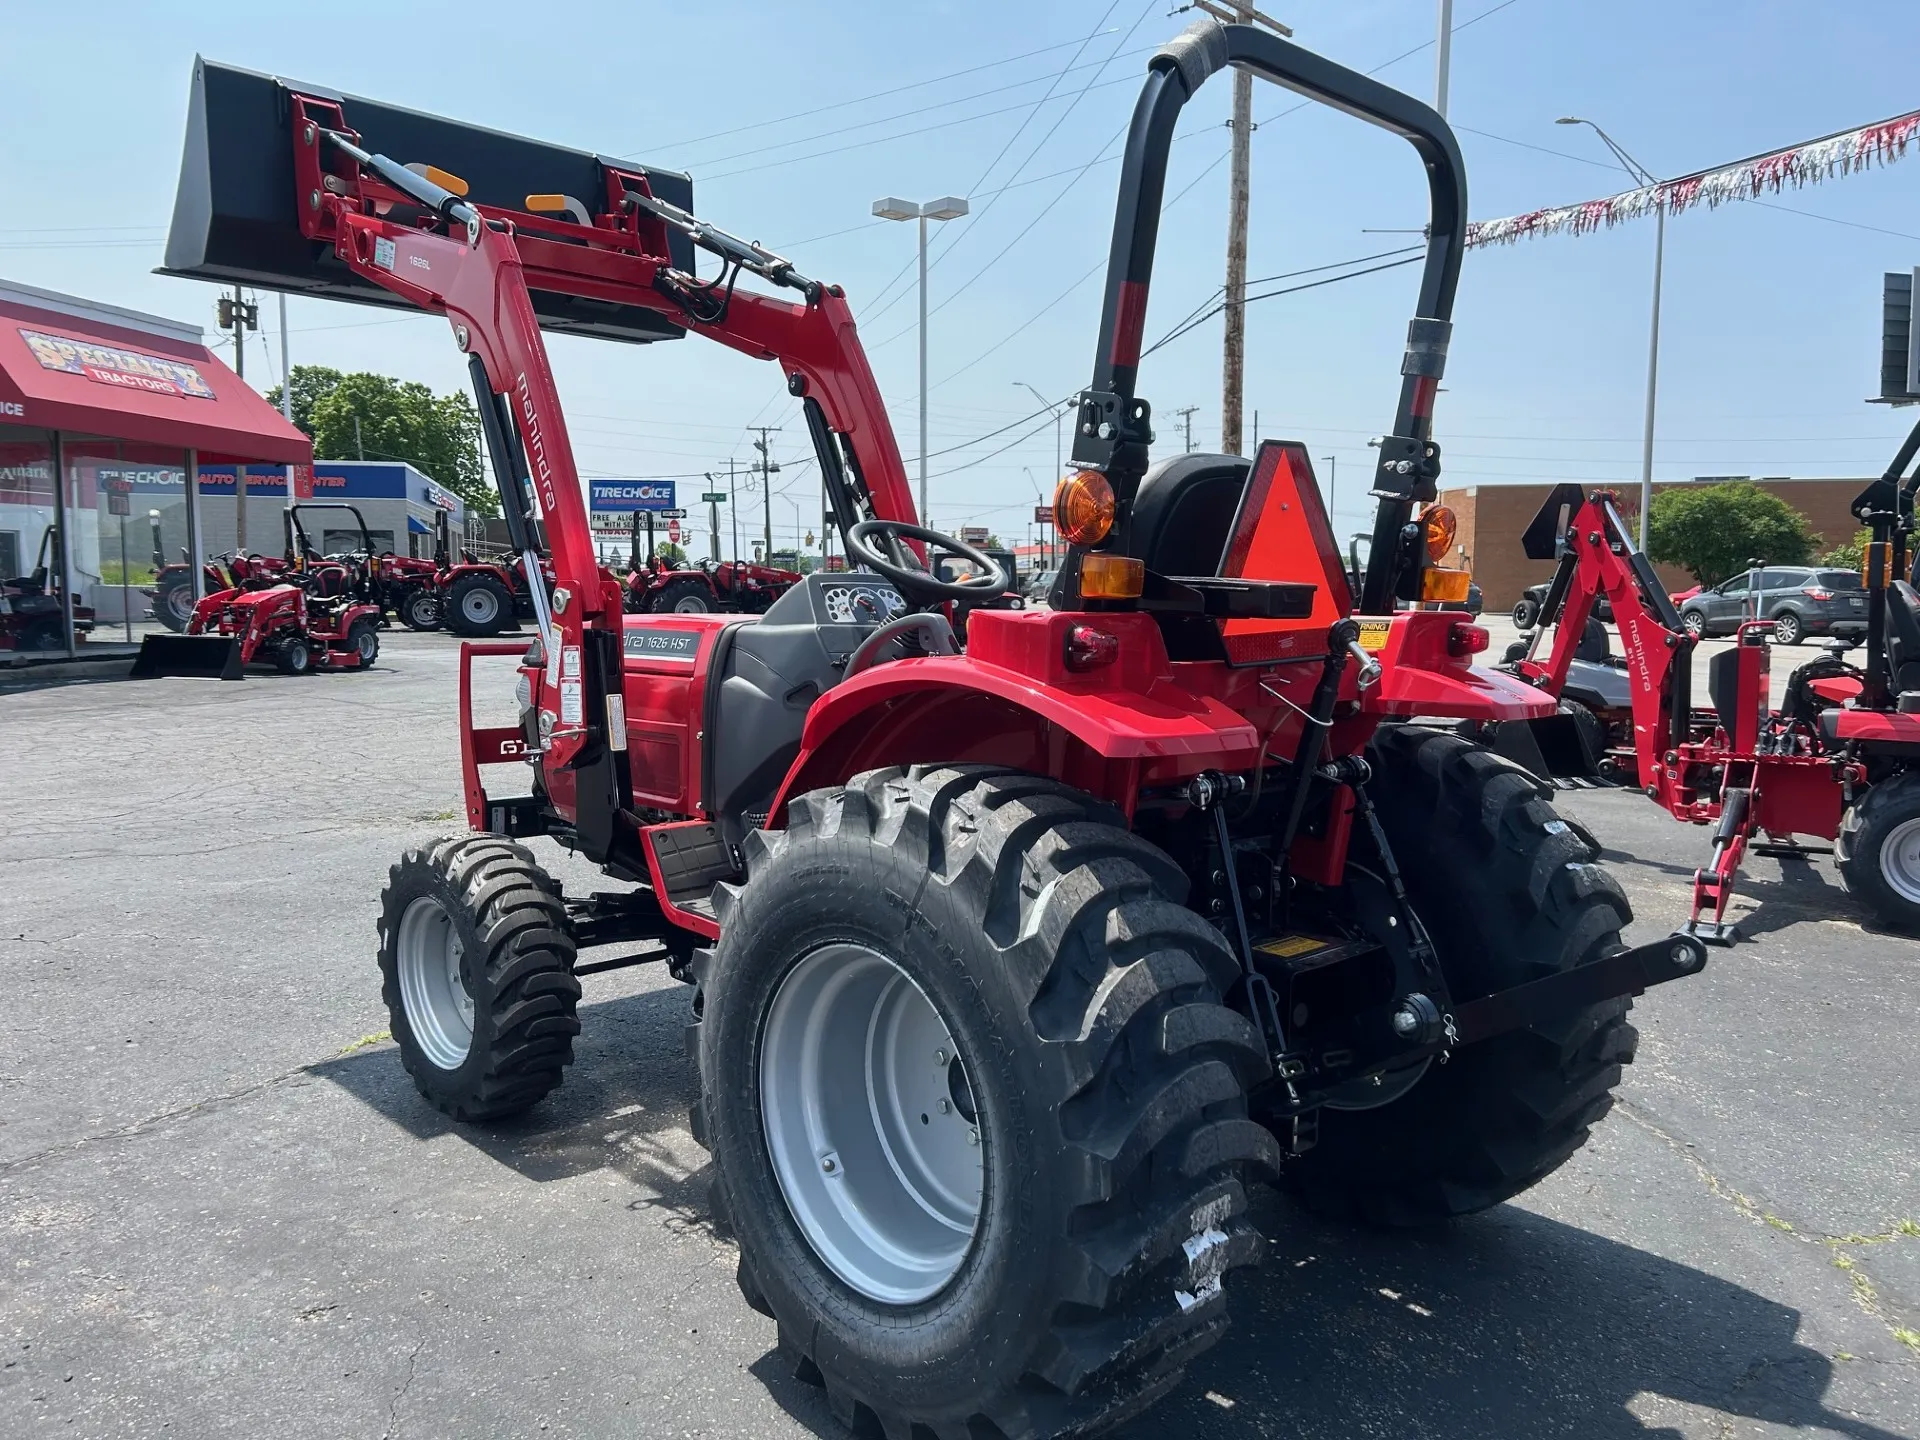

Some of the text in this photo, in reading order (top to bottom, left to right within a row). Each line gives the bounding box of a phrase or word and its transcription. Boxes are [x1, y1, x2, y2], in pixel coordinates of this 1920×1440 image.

[28, 336, 206, 394] SPECIALTY
[92, 369, 176, 393] TRACTORS
[518, 371, 556, 511] mahindra
[198, 474, 235, 484] AUTO
[245, 475, 288, 486] ERVIC
[647, 636, 669, 649] 1626
[670, 637, 692, 650] HST
[1629, 619, 1651, 692] mahindra
